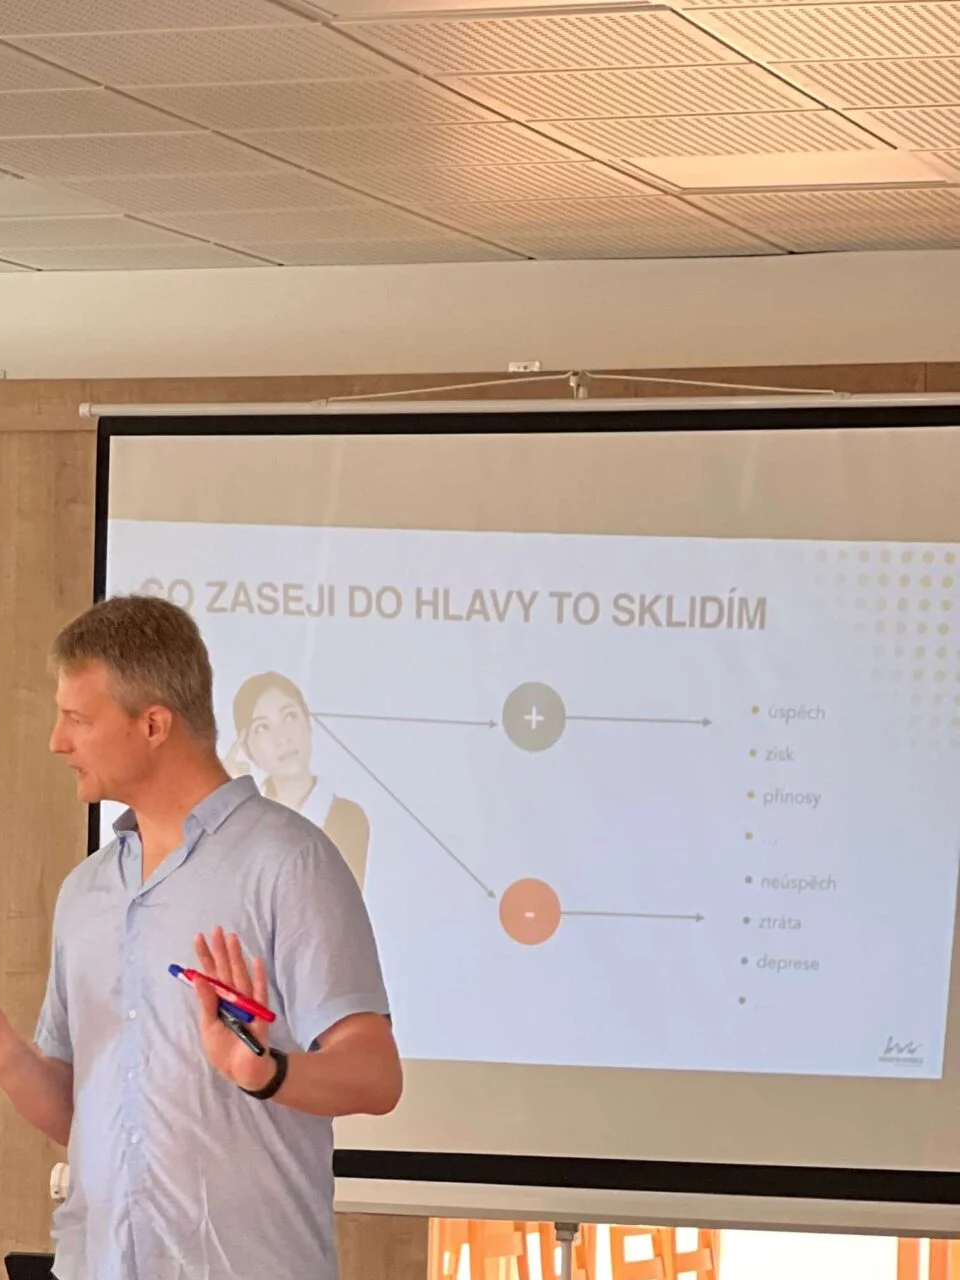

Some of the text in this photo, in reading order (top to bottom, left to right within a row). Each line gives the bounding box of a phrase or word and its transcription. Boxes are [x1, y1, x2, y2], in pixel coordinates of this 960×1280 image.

[205, 581, 336, 617] ZASEJI
[348, 585, 403, 620] DO
[414, 586, 540, 624] HLAVY
[549, 591, 601, 626] TO
[612, 586, 768, 631] SKLIDÍM
[767, 702, 827, 726] úspěch
[765, 745, 795, 762] zisk
[759, 872, 838, 894] neúspěch
[758, 914, 802, 930] ztráta
[756, 953, 821, 974] deprese
